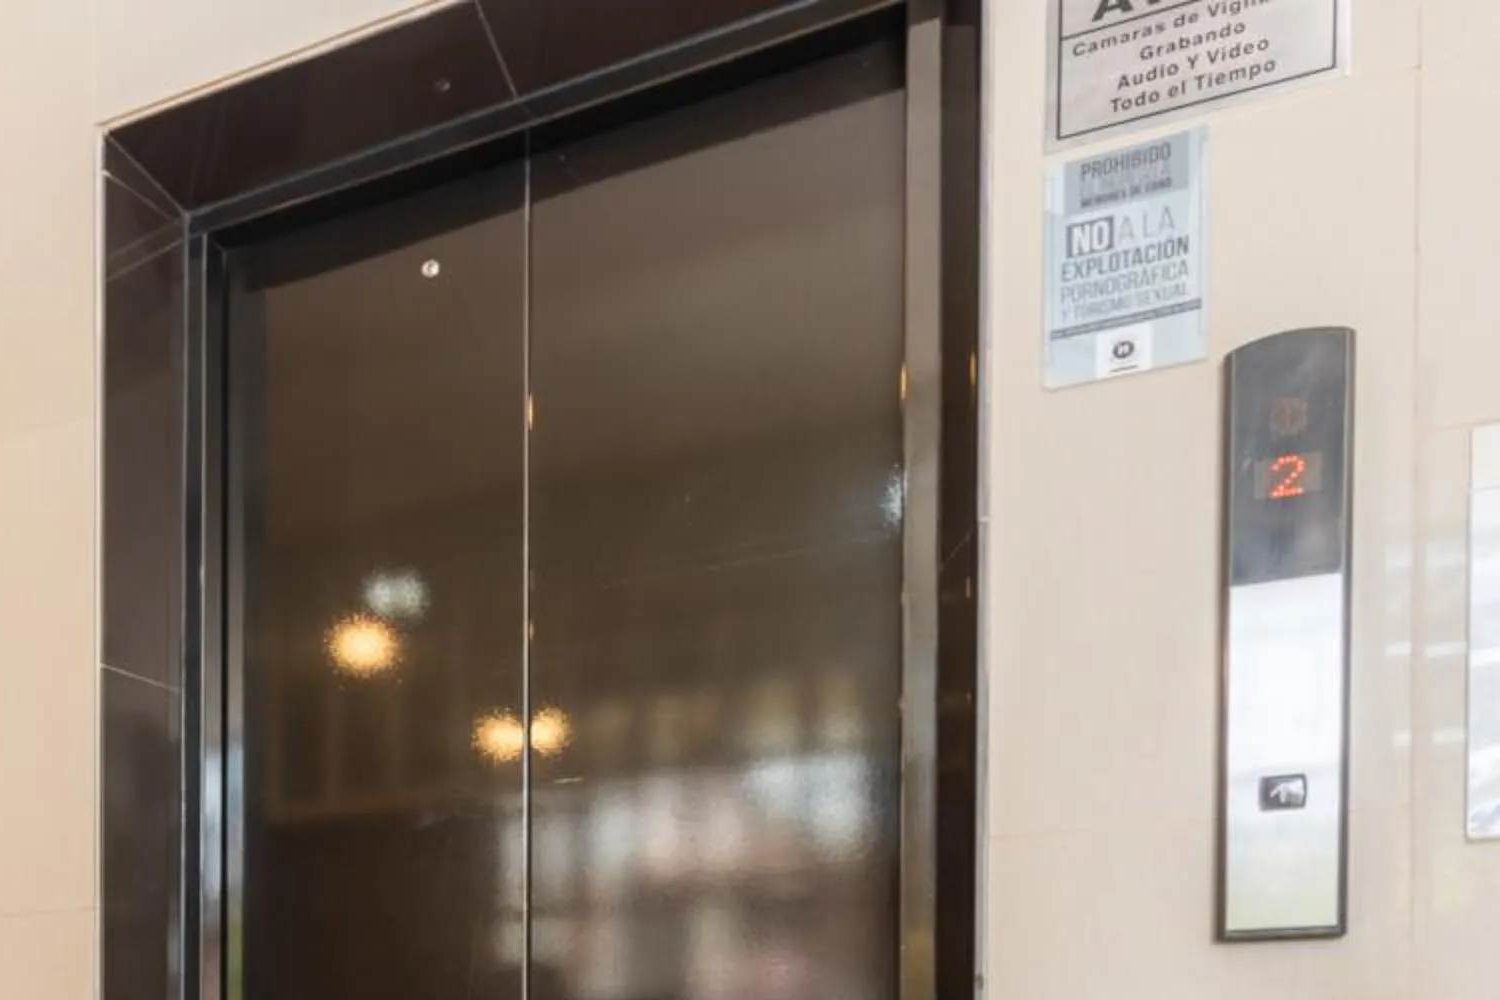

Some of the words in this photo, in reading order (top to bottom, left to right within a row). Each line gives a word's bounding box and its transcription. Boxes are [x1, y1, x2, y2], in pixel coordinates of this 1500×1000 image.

[1073, 22, 1166, 57] Camaras
[1173, 11, 1199, 28] de
[1140, 22, 1246, 60] Grabando
[1110, 89, 1160, 113] Todo
[1167, 79, 1186, 98] el
[1194, 58, 1277, 91] Tiempo
[1117, 63, 1180, 91] Audio
[1187, 53, 1200, 70] Y
[1206, 38, 1270, 65] Video
[1071, 220, 1111, 255] NO
[1119, 216, 1135, 239] A
[1143, 206, 1175, 238] LA
[1268, 453, 1305, 499] 2
